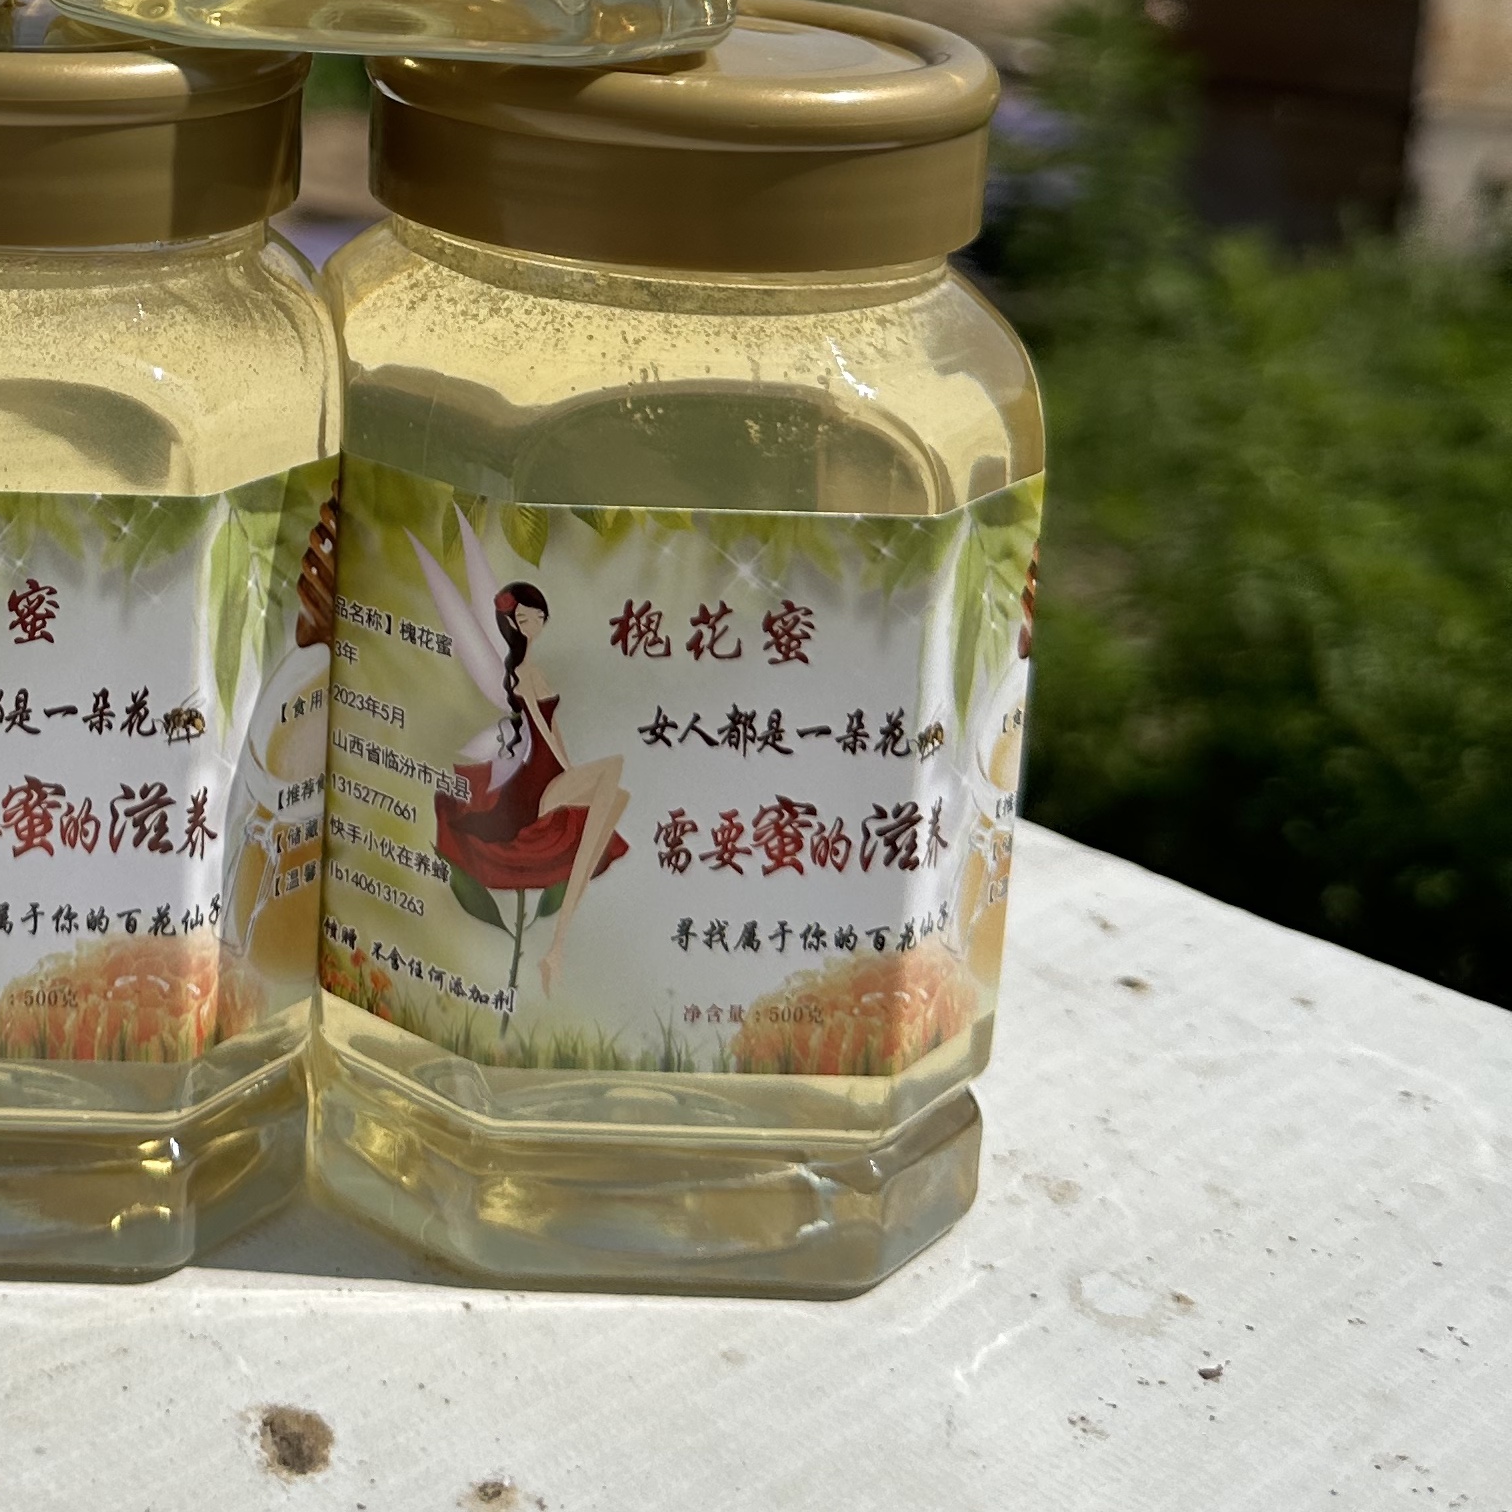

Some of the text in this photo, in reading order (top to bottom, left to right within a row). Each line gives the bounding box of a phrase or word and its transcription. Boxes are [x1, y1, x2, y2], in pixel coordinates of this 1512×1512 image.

[609, 598, 816, 666] 槐花蜜
[334, 685, 405, 728] 2023年5月
[638, 705, 912, 761] 女人都是一朵花
[333, 729, 470, 800] 山西省临汾市古县
[332, 774, 416, 823] 13152777661
[330, 815, 449, 882] 快手小伙在养蜂
[654, 794, 948, 878] 需要蜜的滋养
[670, 903, 950, 955] 寻找属于你的百花仙子
